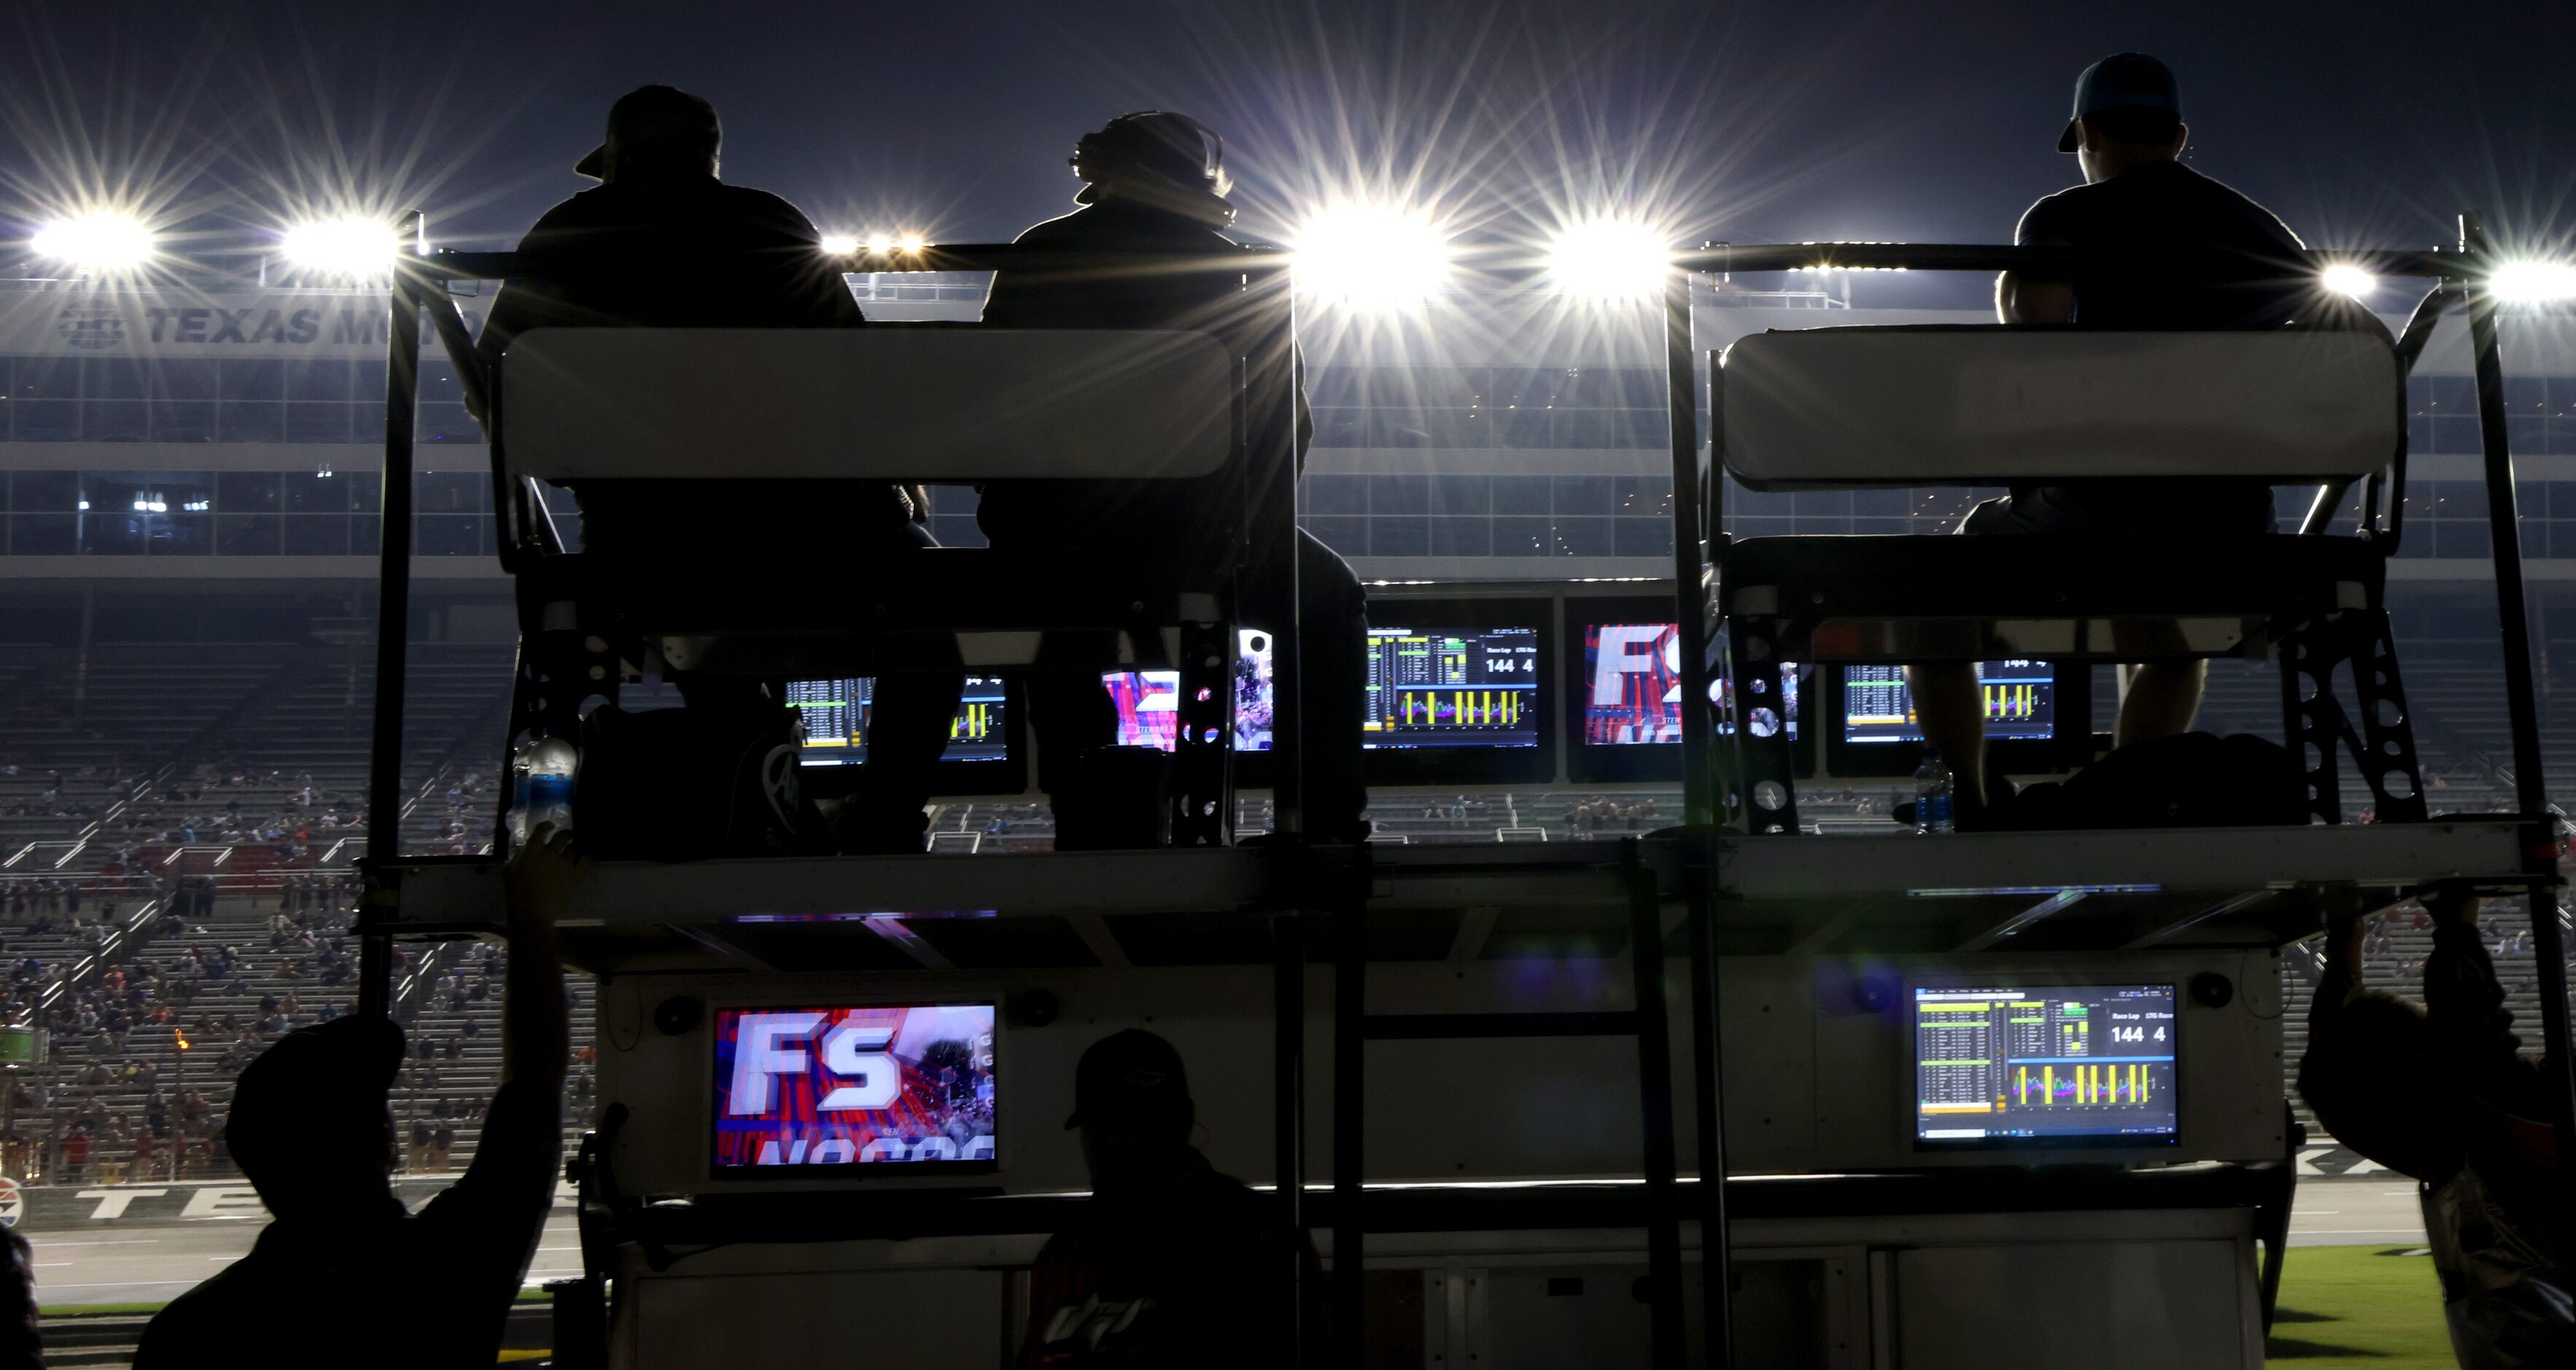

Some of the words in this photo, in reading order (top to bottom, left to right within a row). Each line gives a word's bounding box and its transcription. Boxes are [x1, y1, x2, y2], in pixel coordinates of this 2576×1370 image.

[147, 309, 319, 344] TEXAS
[1486, 659, 1515, 673] 144
[1522, 659, 1534, 673] 4
[1593, 625, 1682, 705] F
[2111, 1026, 2144, 1042] 144
[2153, 1026, 2167, 1042] 4
